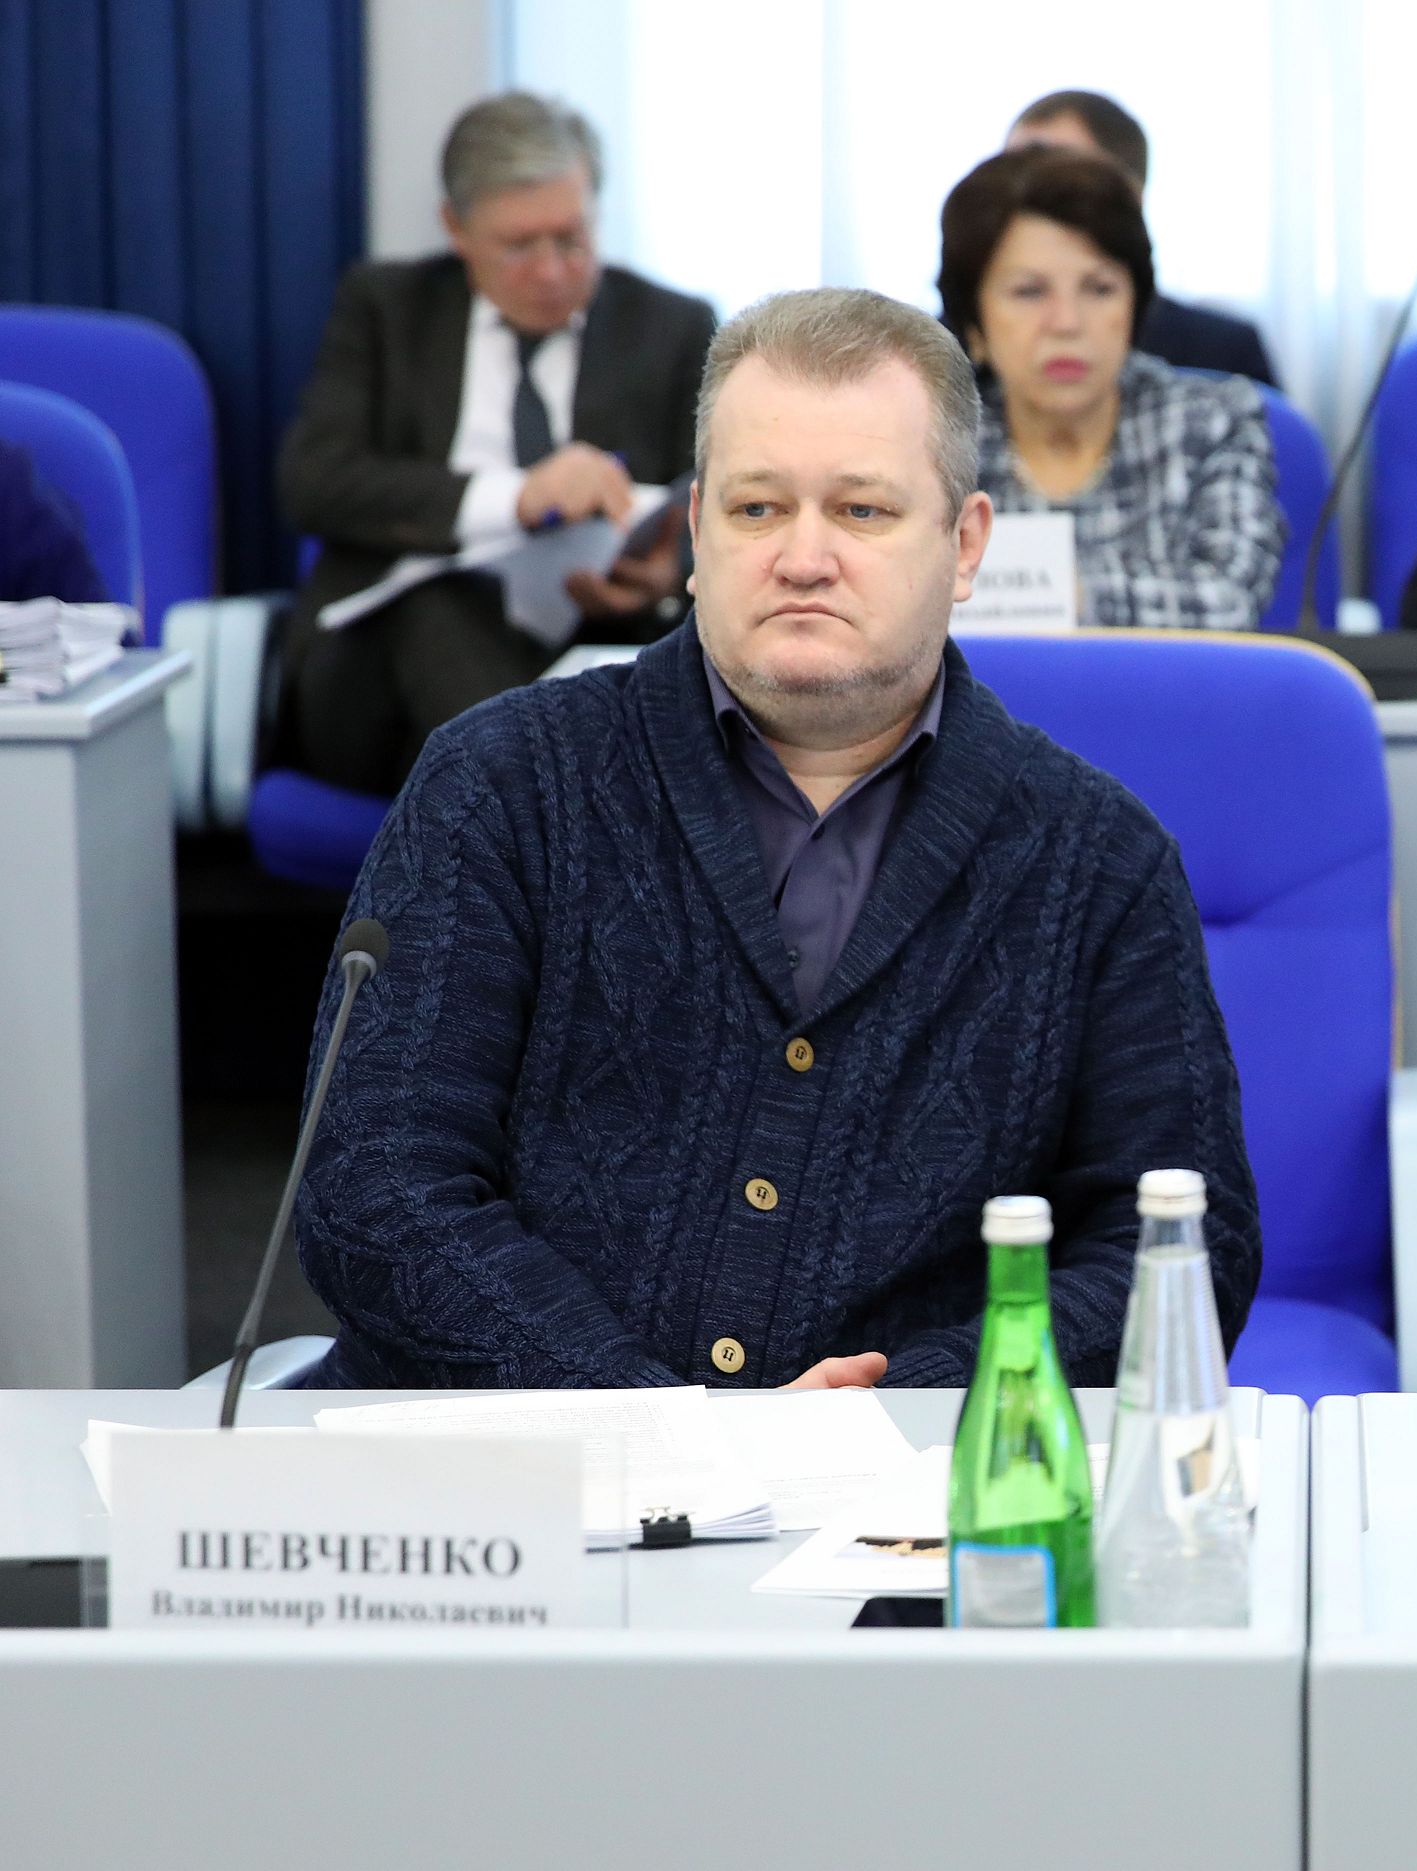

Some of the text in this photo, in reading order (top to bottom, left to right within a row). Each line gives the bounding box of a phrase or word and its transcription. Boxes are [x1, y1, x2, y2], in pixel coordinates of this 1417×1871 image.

[176, 1530, 522, 1577] ШЕВЧЕНКО
[152, 1590, 549, 1629] Владимир Николаевич
